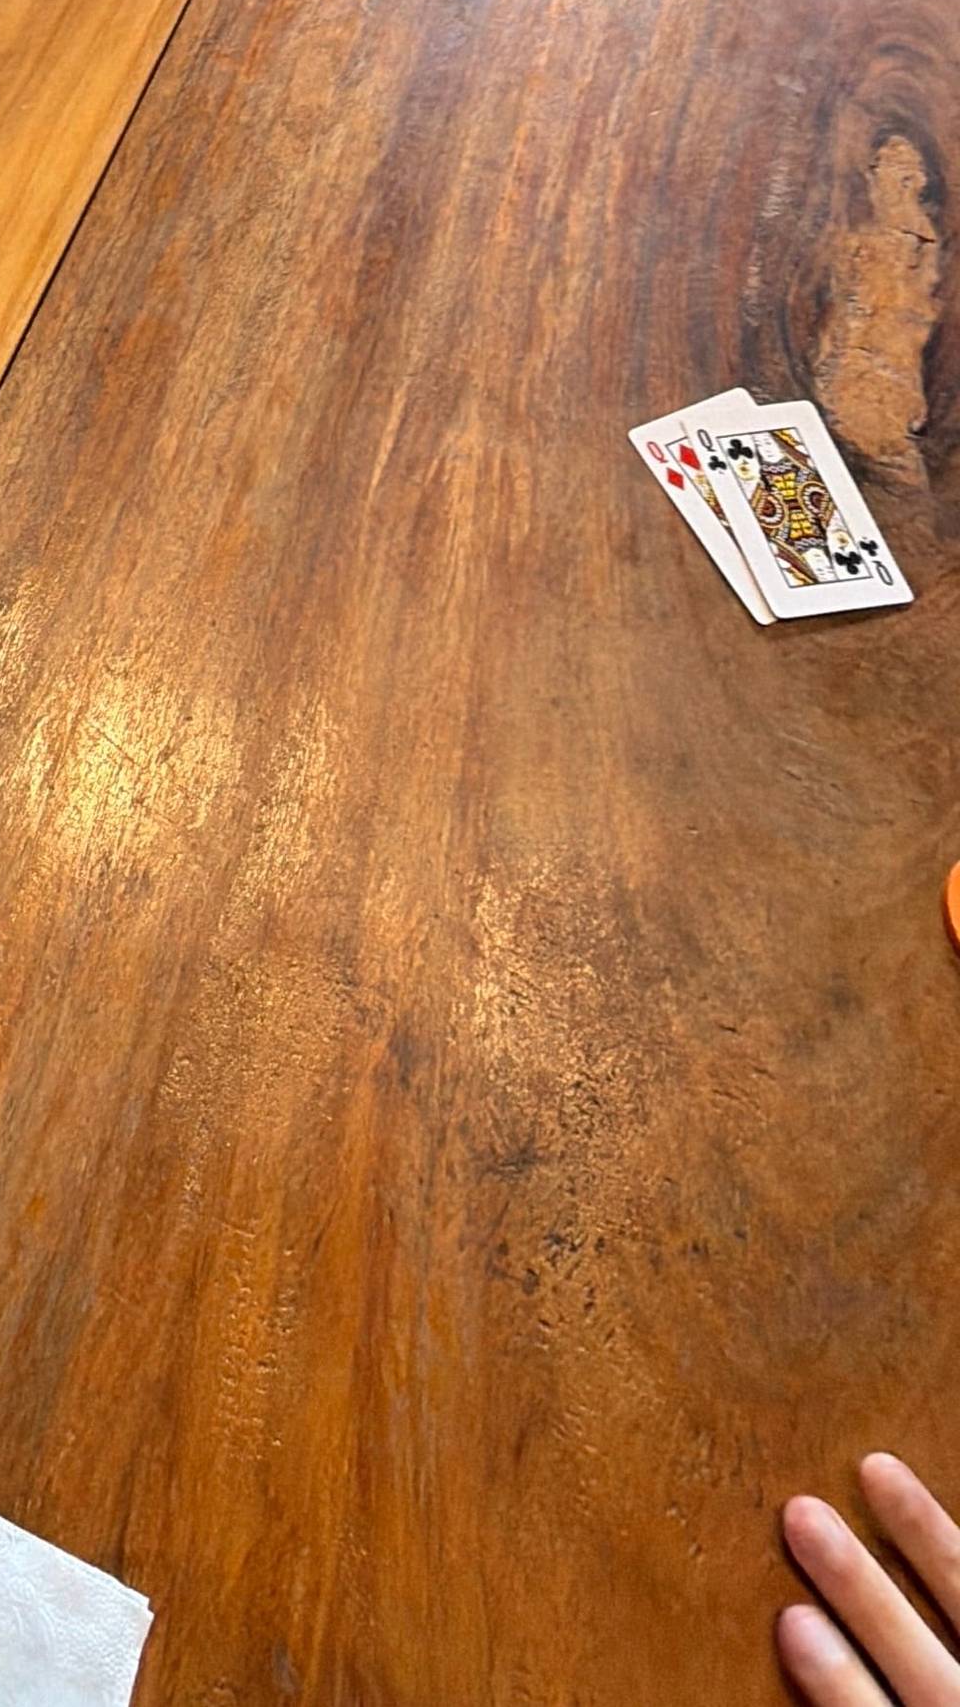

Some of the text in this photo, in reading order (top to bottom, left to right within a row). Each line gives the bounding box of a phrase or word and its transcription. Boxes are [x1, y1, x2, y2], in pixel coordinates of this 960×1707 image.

[646, 440, 668, 464] Q
[696, 428, 716, 452] Q
[872, 559, 894, 586] Q
